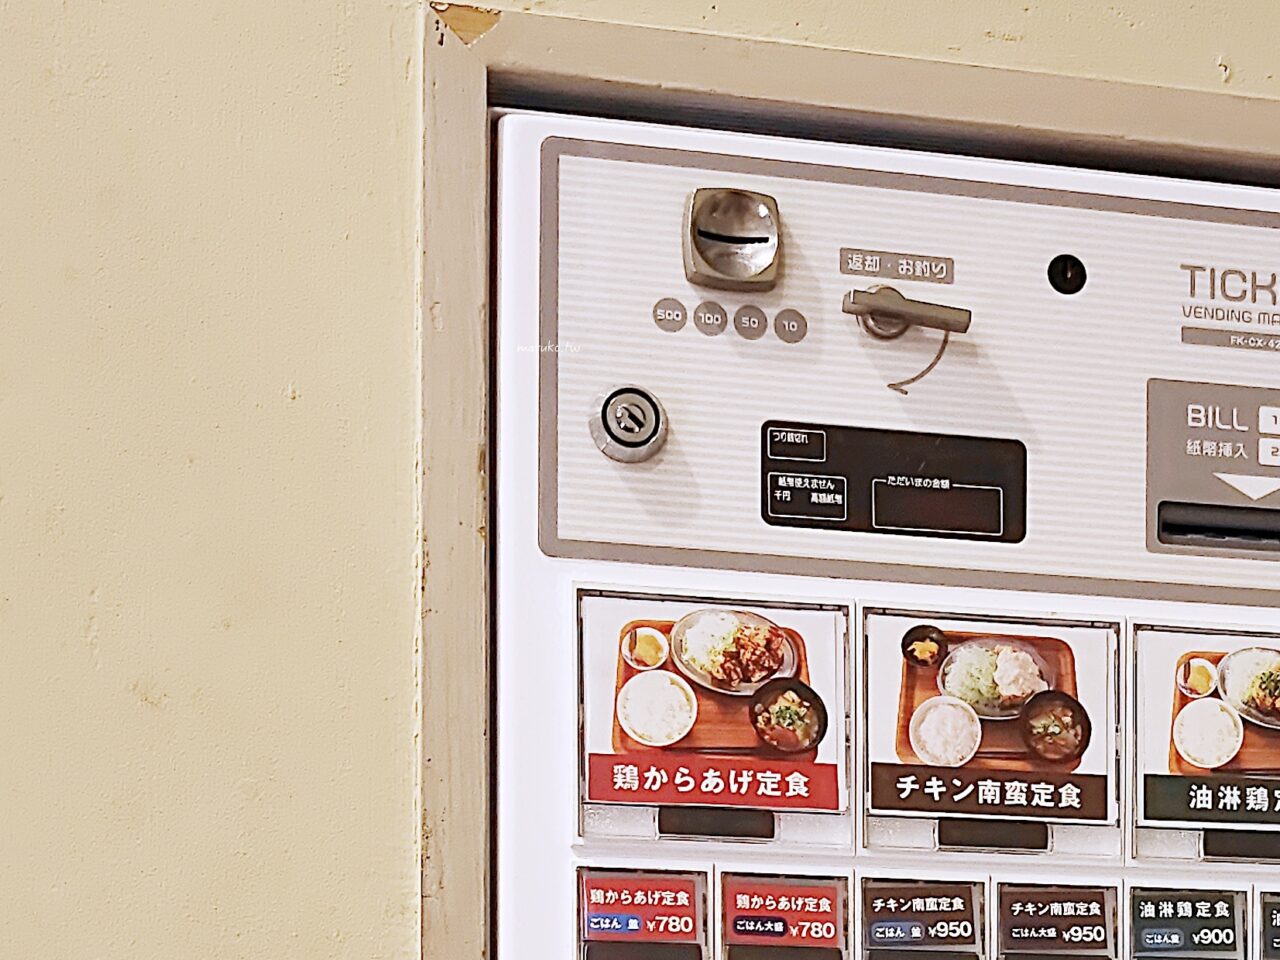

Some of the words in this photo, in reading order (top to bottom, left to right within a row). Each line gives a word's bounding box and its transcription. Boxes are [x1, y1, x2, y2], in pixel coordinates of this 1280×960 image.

[657, 310, 682, 321] 500
[699, 313, 722, 325] 100
[741, 317, 759, 329] 50
[783, 320, 798, 332] 10
[1182, 306, 1252, 324] VENDING
[1188, 405, 1249, 431] BILL
[612, 765, 810, 799] 鶏からあげ定食
[896, 775, 1082, 807] チキン南蛮定食
[590, 889, 689, 906] 鶏からあげ定食
[736, 894, 832, 913] 鶏からあげ定食
[646, 916, 694, 932] ¥780
[790, 921, 836, 938] ¥780
[928, 921, 972, 938] ¥950
[1062, 926, 1105, 942] ¥950
[1192, 929, 1234, 944] ¥900
